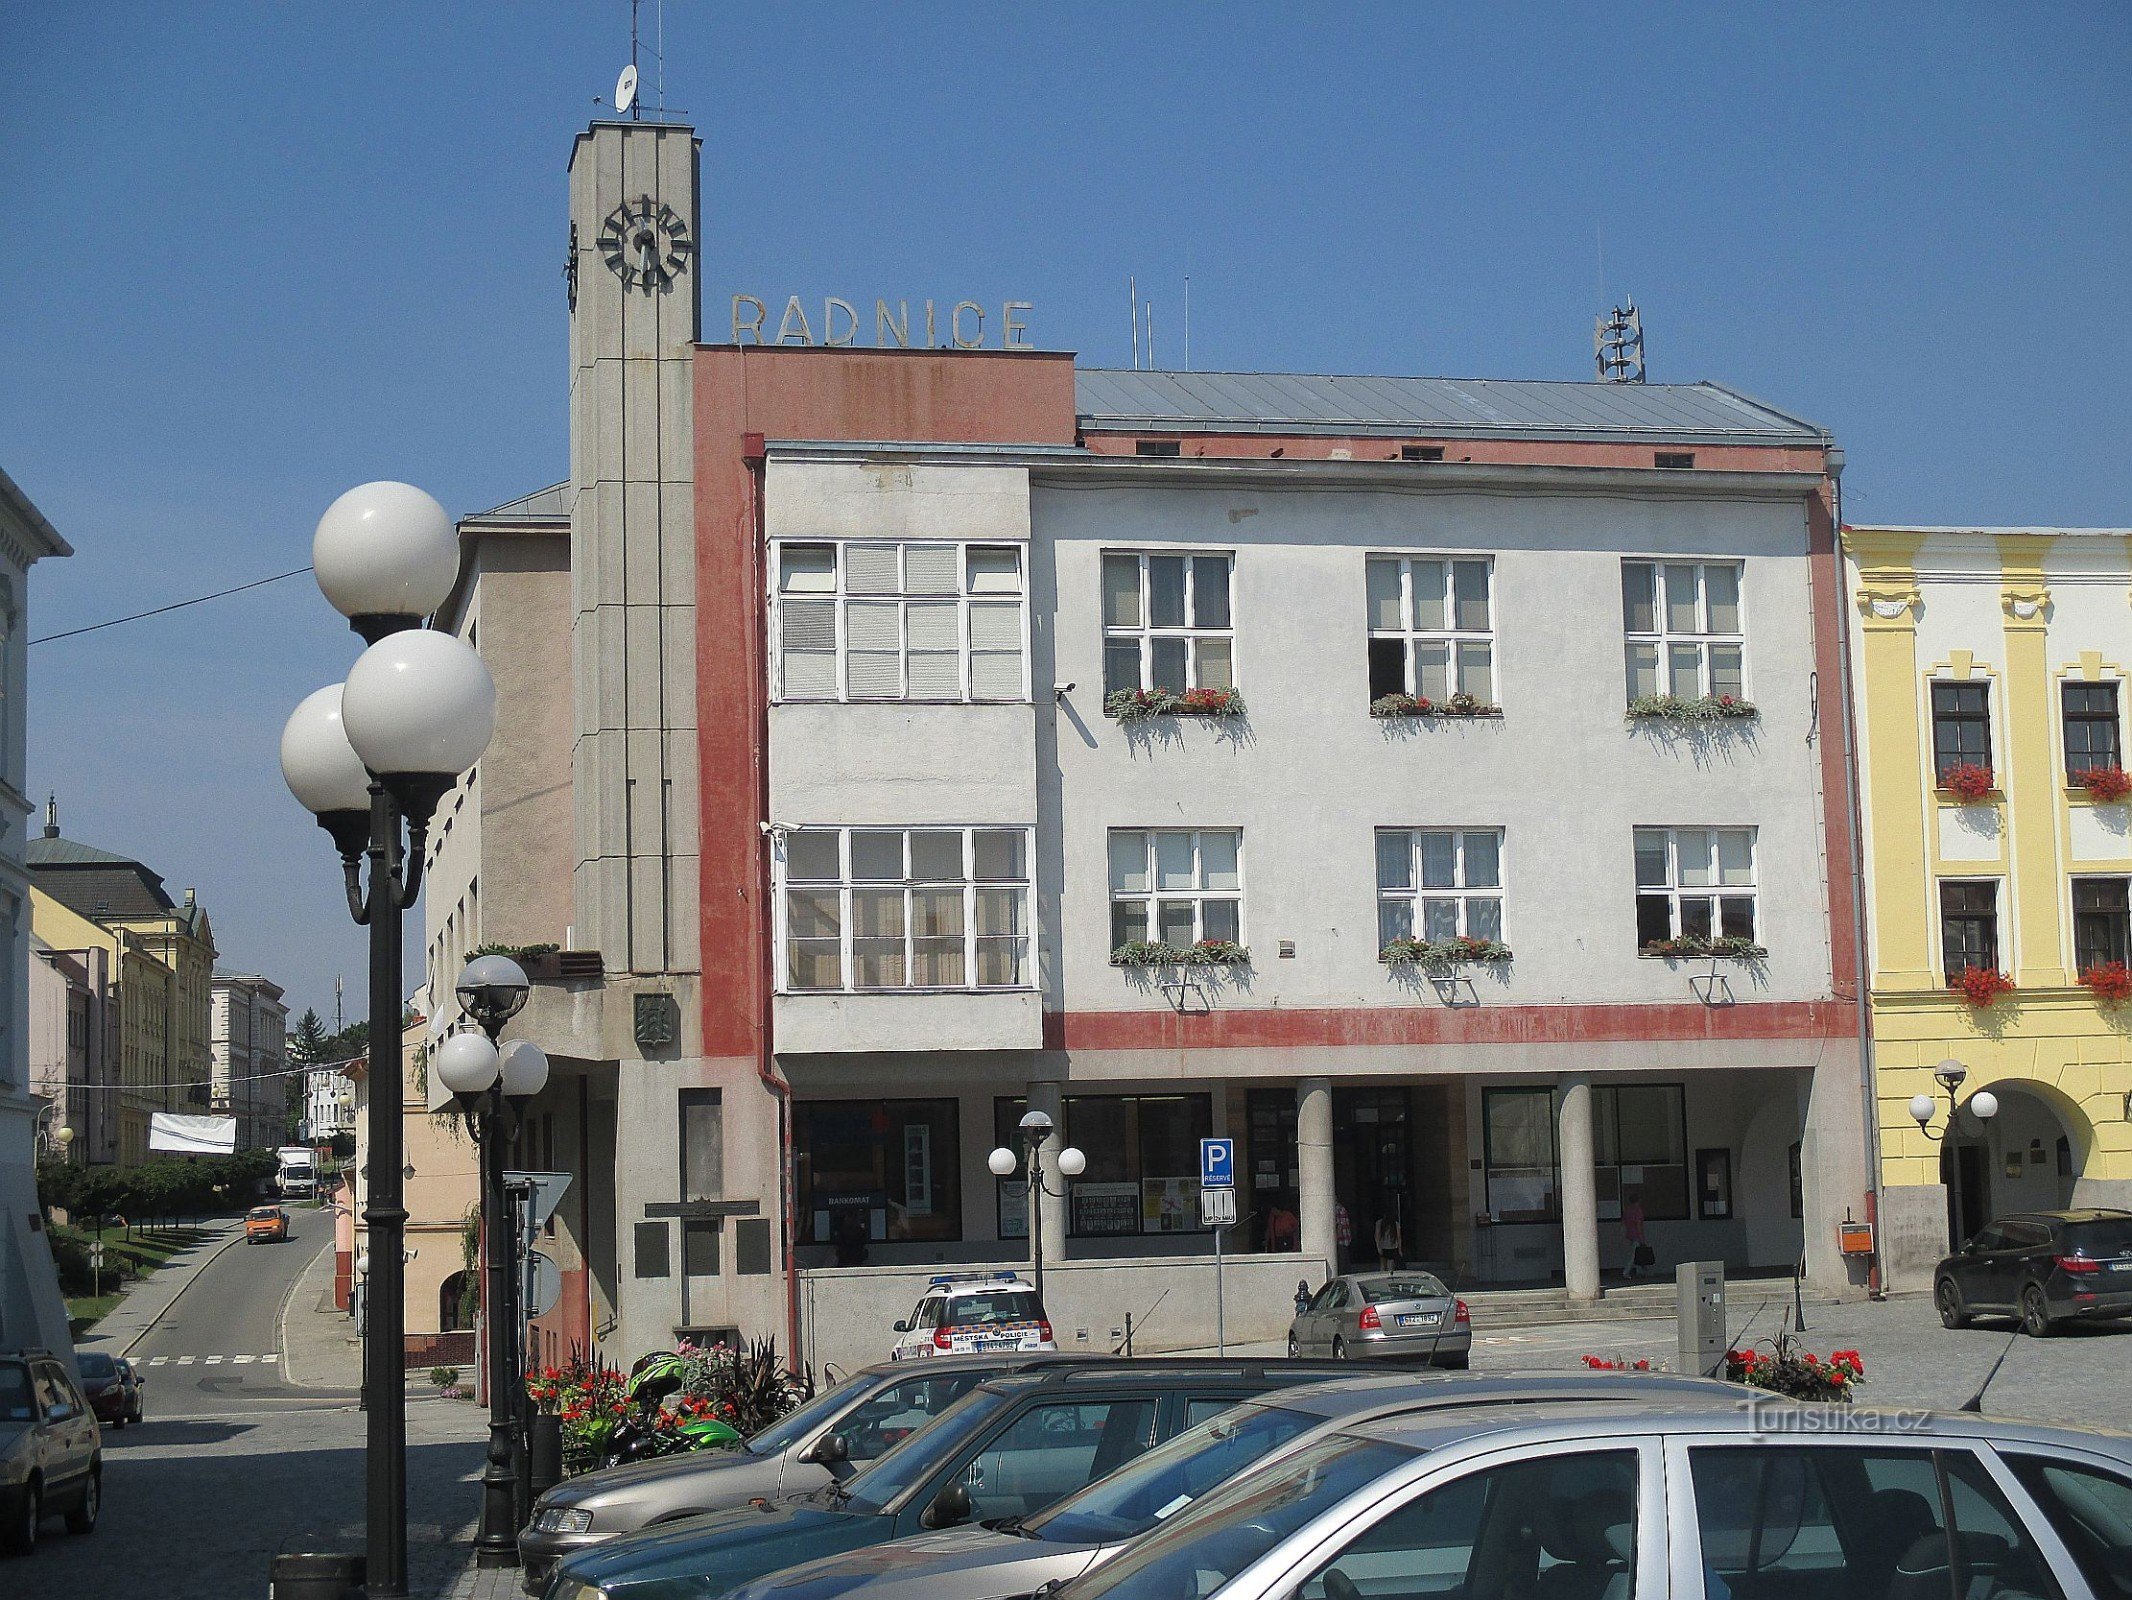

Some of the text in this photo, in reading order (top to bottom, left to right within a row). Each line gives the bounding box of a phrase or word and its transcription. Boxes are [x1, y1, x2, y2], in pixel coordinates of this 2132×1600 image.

[731, 295, 1034, 349] RADNICE
[1208, 1145, 1227, 1172] P
[828, 1196, 871, 1206] BANKOMAT
